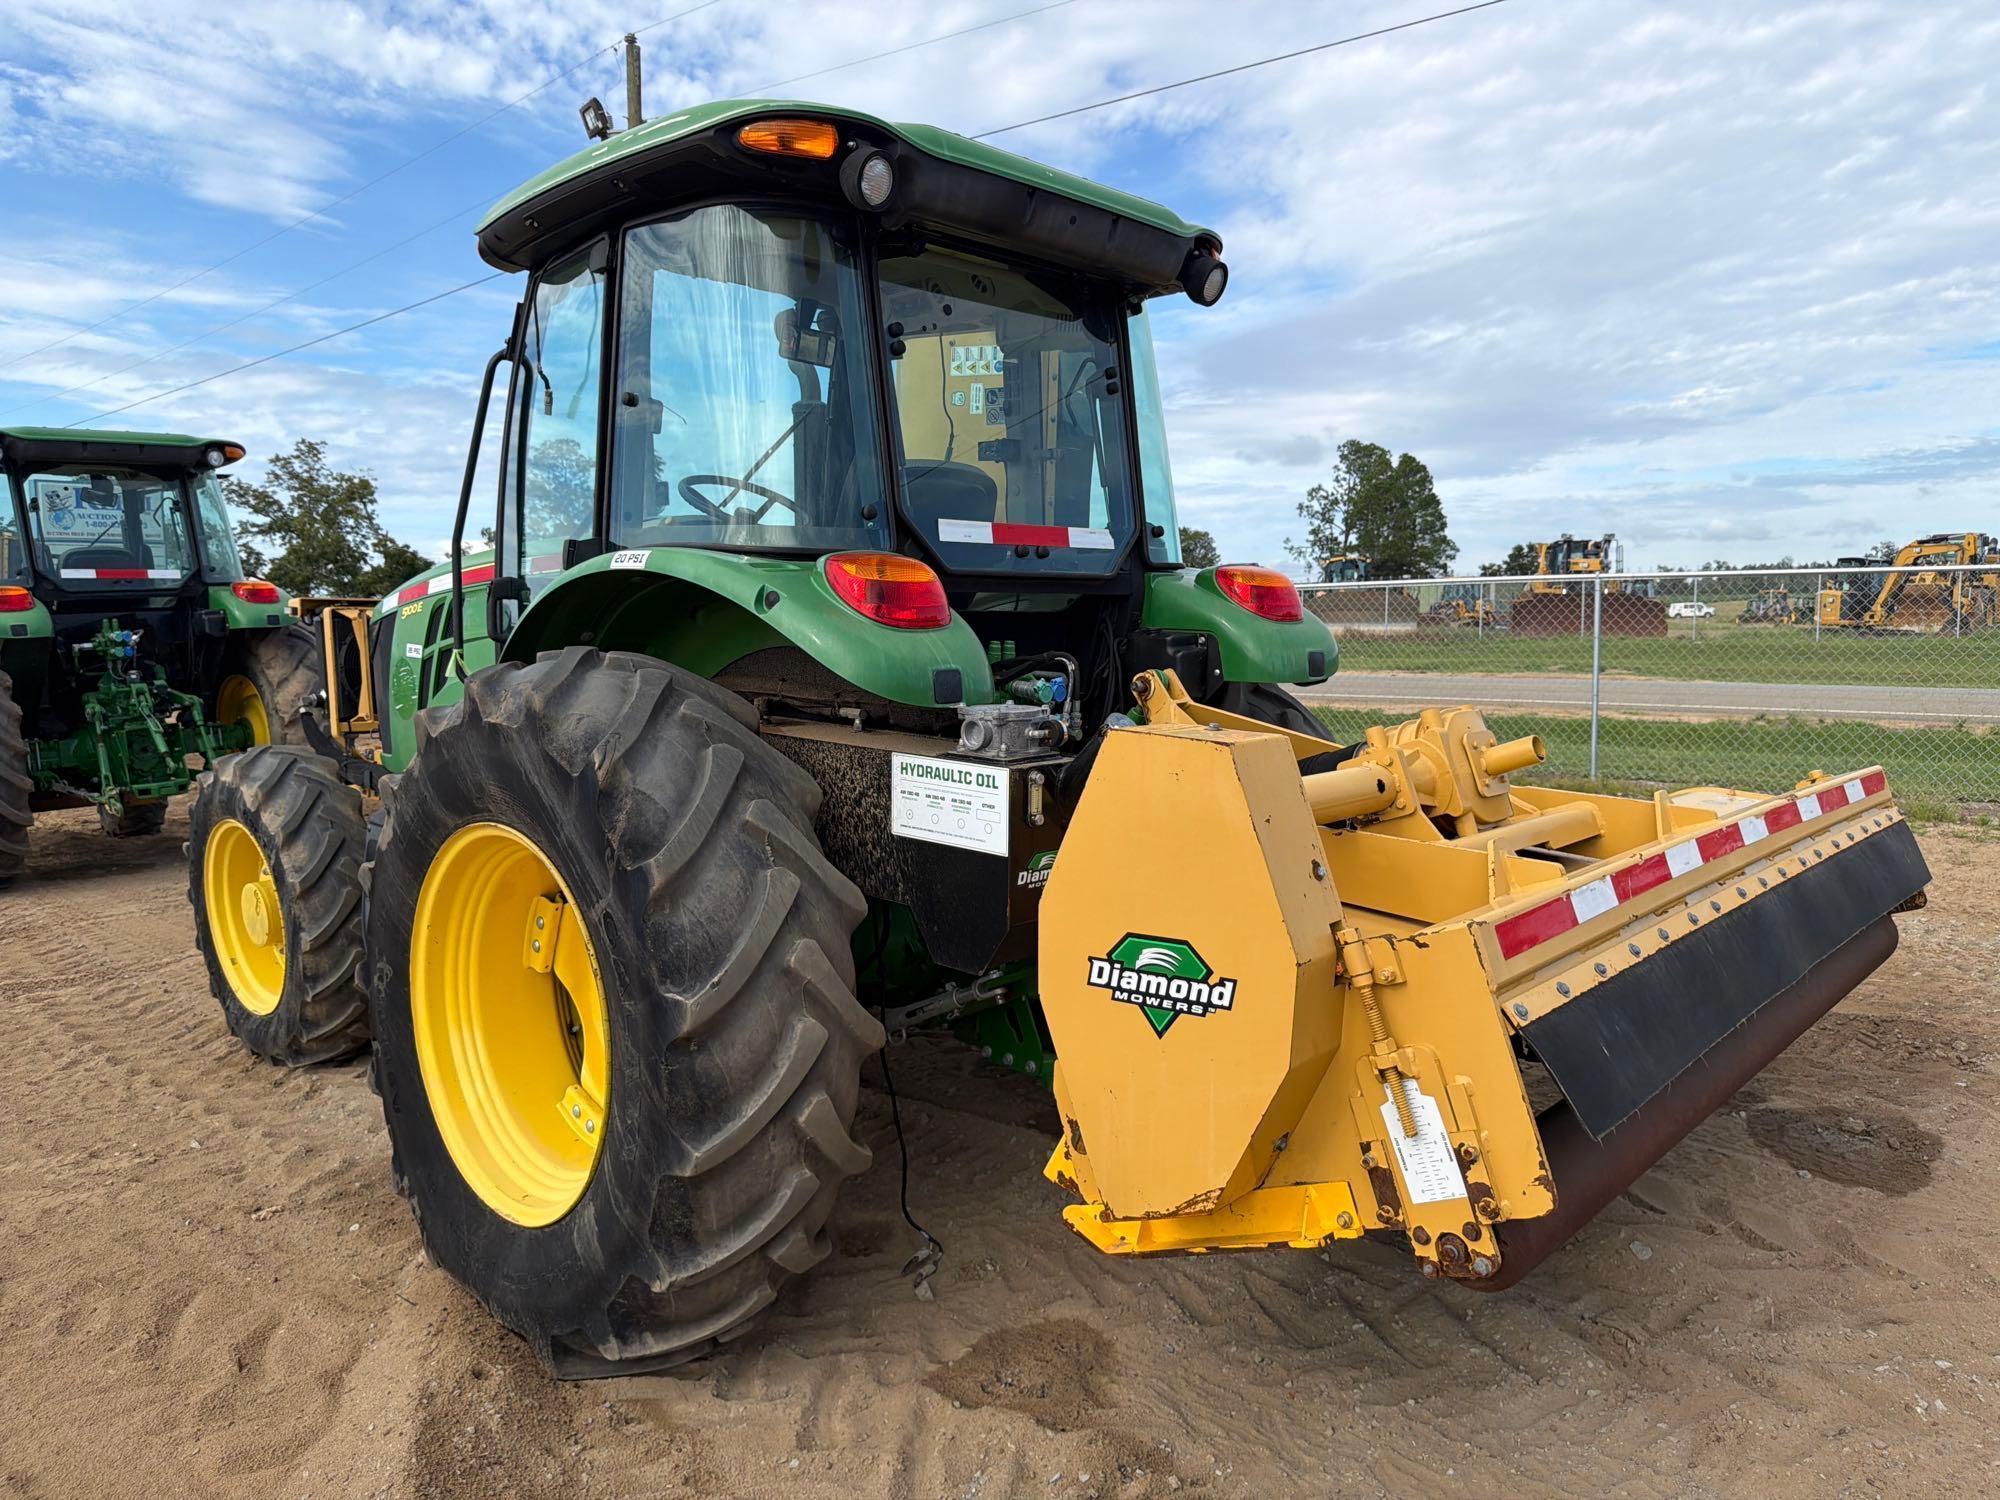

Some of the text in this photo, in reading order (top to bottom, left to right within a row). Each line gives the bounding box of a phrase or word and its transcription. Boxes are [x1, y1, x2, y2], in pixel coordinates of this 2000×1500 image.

[614, 554, 645, 563] 20 PSI
[900, 761, 999, 790] HYDRAULIC OIL
[1089, 958, 1234, 1007] Diamond
[1114, 990, 1204, 1014] MOWERS
